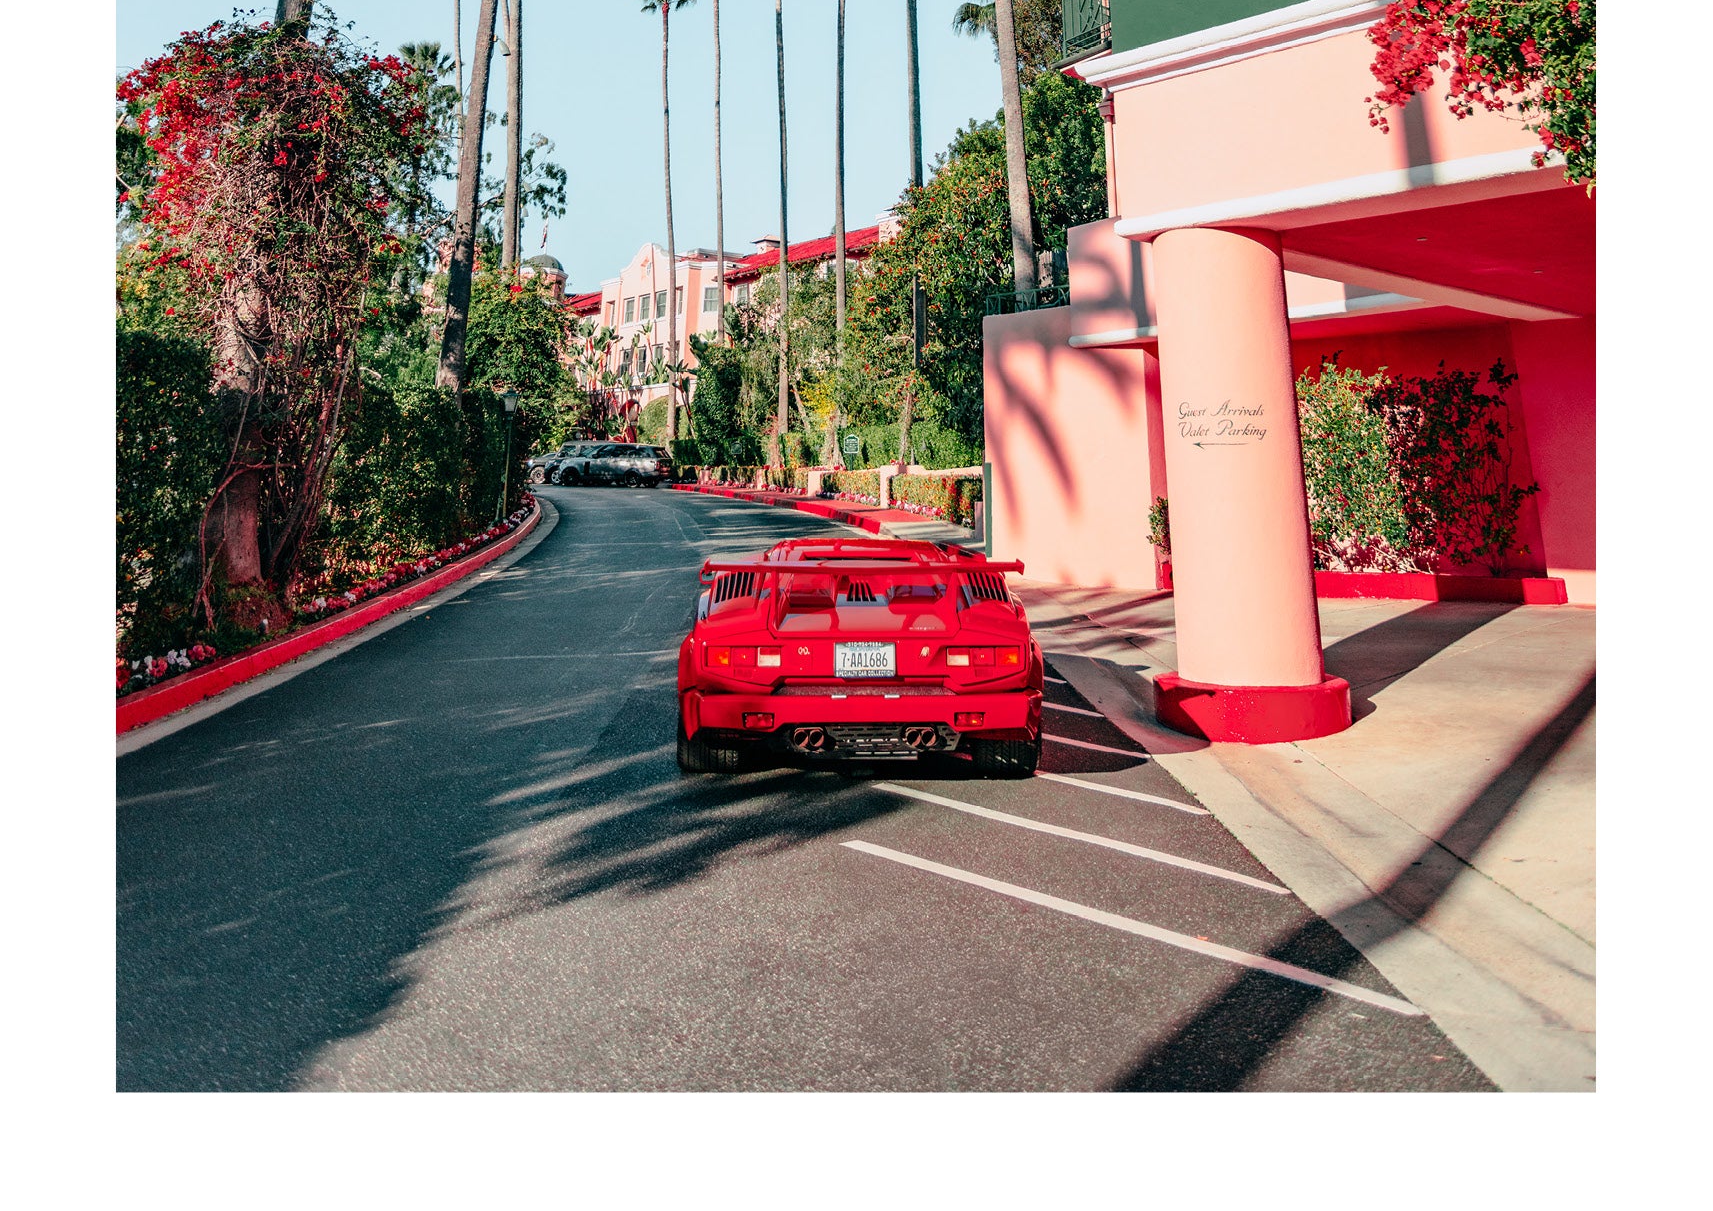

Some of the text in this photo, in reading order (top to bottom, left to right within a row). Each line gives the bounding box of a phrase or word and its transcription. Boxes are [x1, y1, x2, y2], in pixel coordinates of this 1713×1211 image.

[1178, 399, 1265, 420] Guest Arrivals
[1178, 419, 1267, 440] Valet Parking
